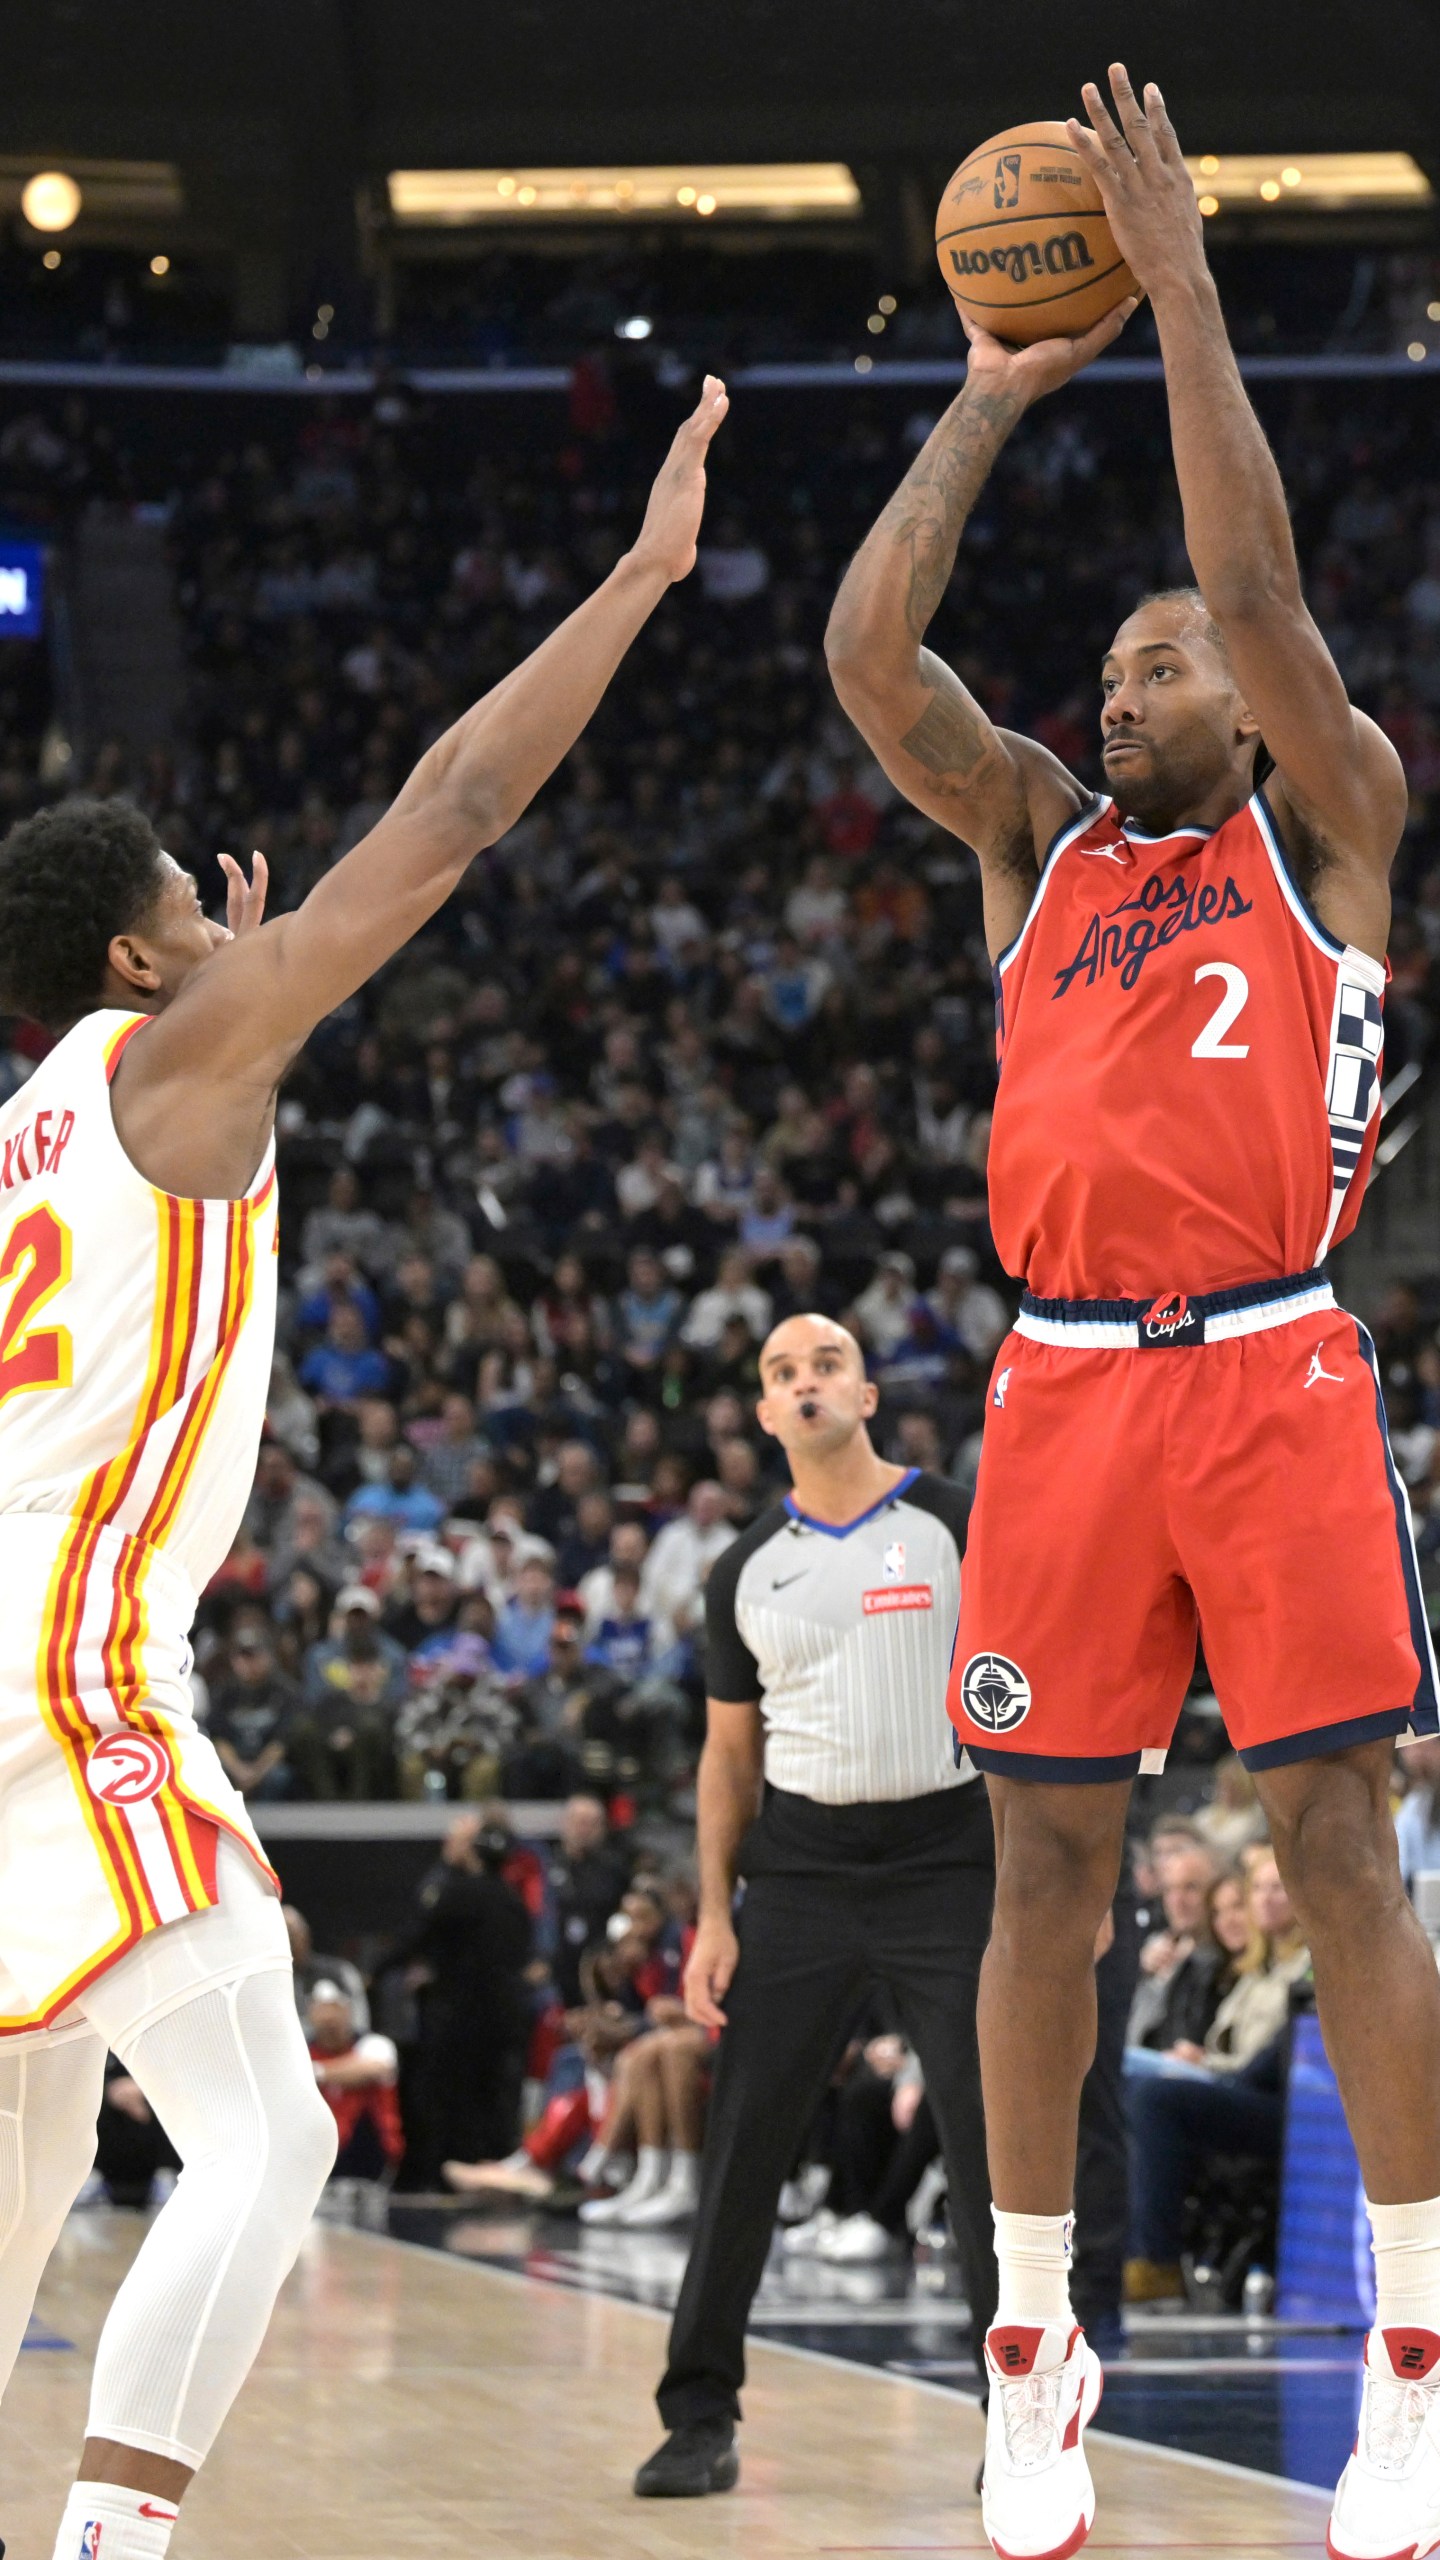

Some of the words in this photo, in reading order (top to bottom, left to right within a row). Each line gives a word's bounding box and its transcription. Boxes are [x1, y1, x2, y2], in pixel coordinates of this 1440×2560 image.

[950, 231, 1095, 283] Wilson
[1105, 874, 1191, 919] Los
[1051, 876, 1253, 1000] Angeles
[1191, 961, 1250, 1059] 2
[864, 1591, 931, 1611] Emirates
